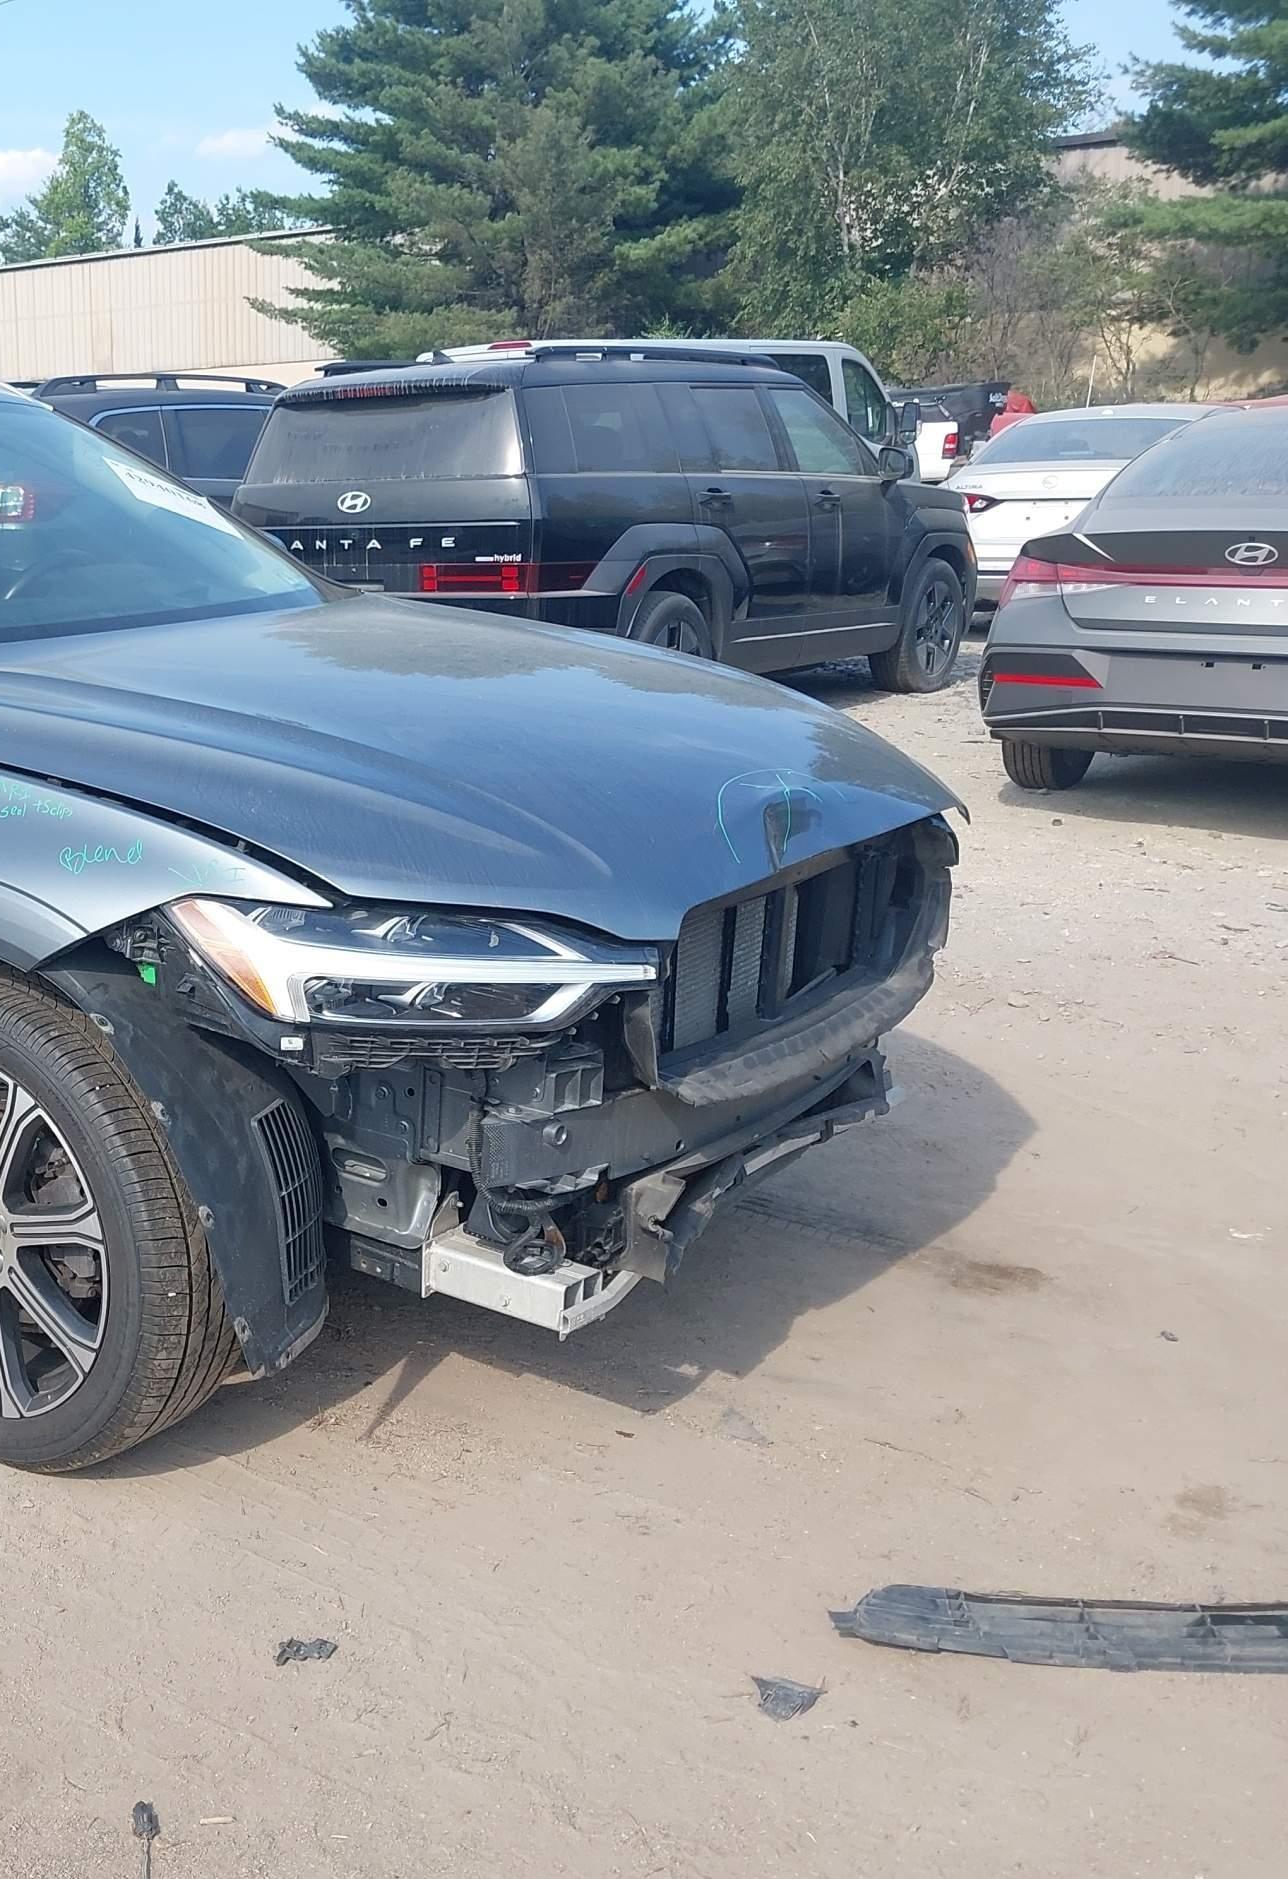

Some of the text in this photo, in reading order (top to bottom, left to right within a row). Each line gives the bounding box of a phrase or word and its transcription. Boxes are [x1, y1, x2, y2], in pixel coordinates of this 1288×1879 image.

[290, 537, 455, 550] ANTA FE
[493, 553, 522, 563] hybrid
[1144, 595, 1285, 607] ELANT
